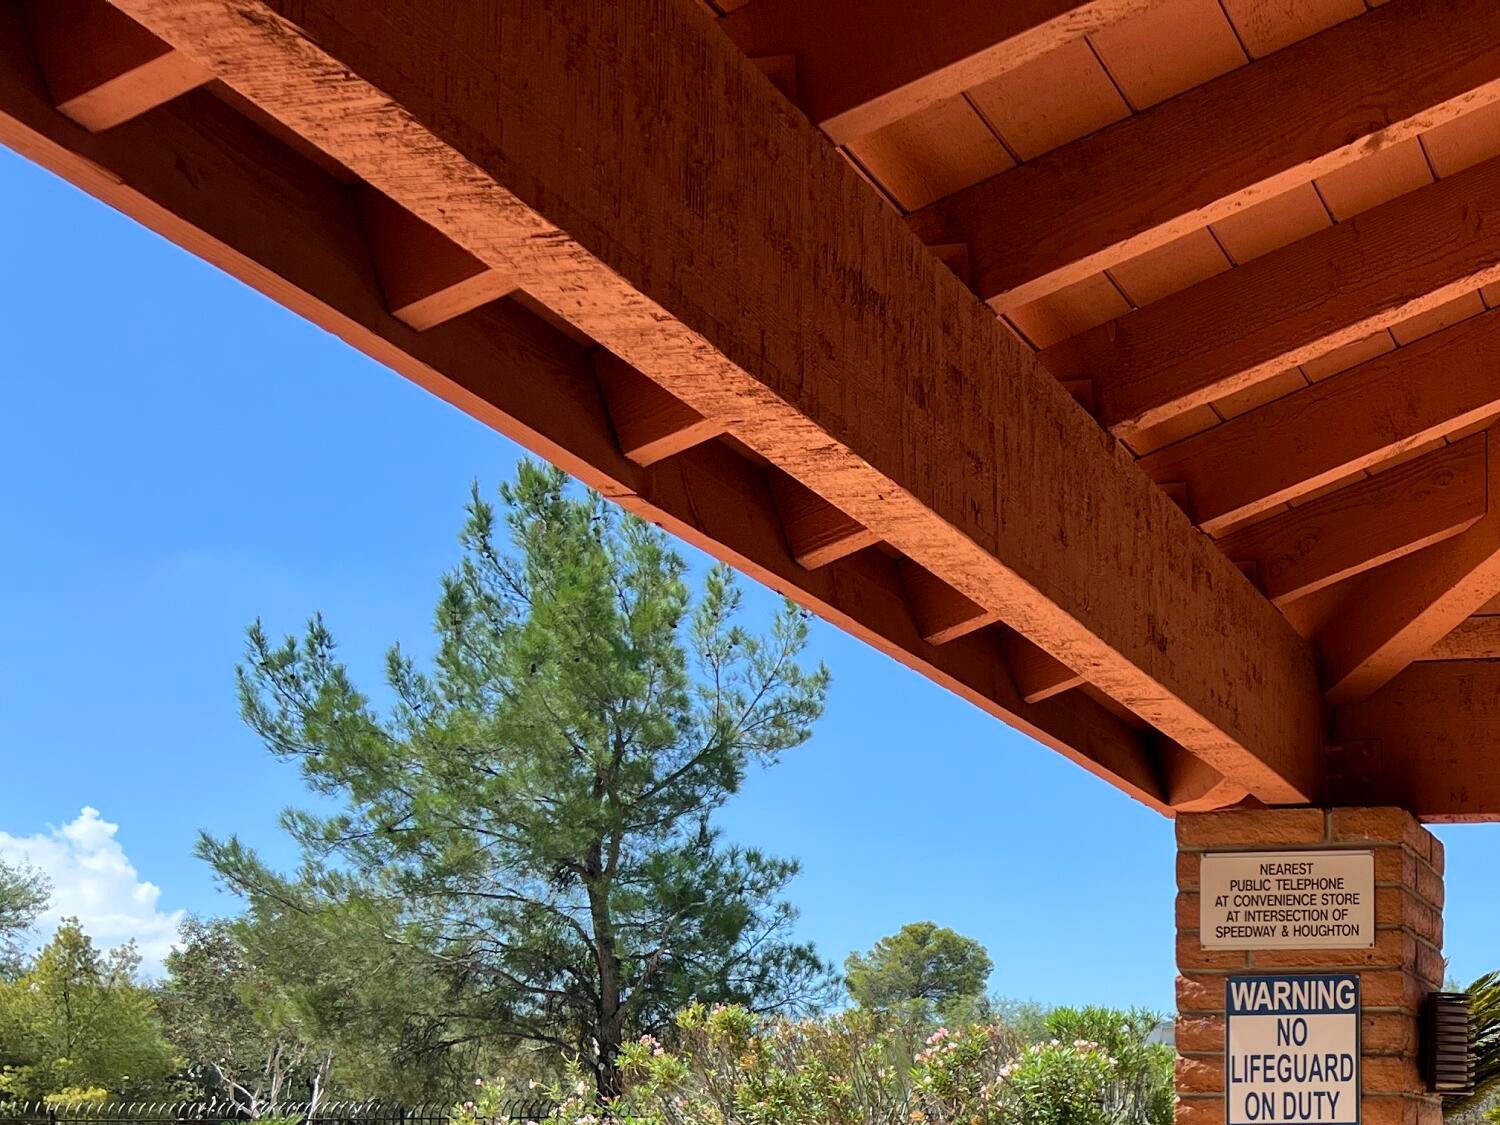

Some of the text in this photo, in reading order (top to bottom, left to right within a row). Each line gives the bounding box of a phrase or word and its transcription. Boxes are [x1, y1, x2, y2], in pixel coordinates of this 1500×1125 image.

[1260, 863, 1314, 875] NEAREST
[1230, 878, 1344, 891] PUBLIC TELEPHONE
[1215, 893, 1360, 907] AT CONVENIENCE STORE
[1226, 909, 1349, 922] AT INTERSECTION OF
[1216, 924, 1360, 938] SPEEDWAY & HOUGHTON
[1230, 980, 1356, 1011] WARNING
[1277, 1017, 1307, 1047] NO
[1231, 1053, 1354, 1083] LIFEGUARD
[1245, 1091, 1340, 1121] ON DUTY
